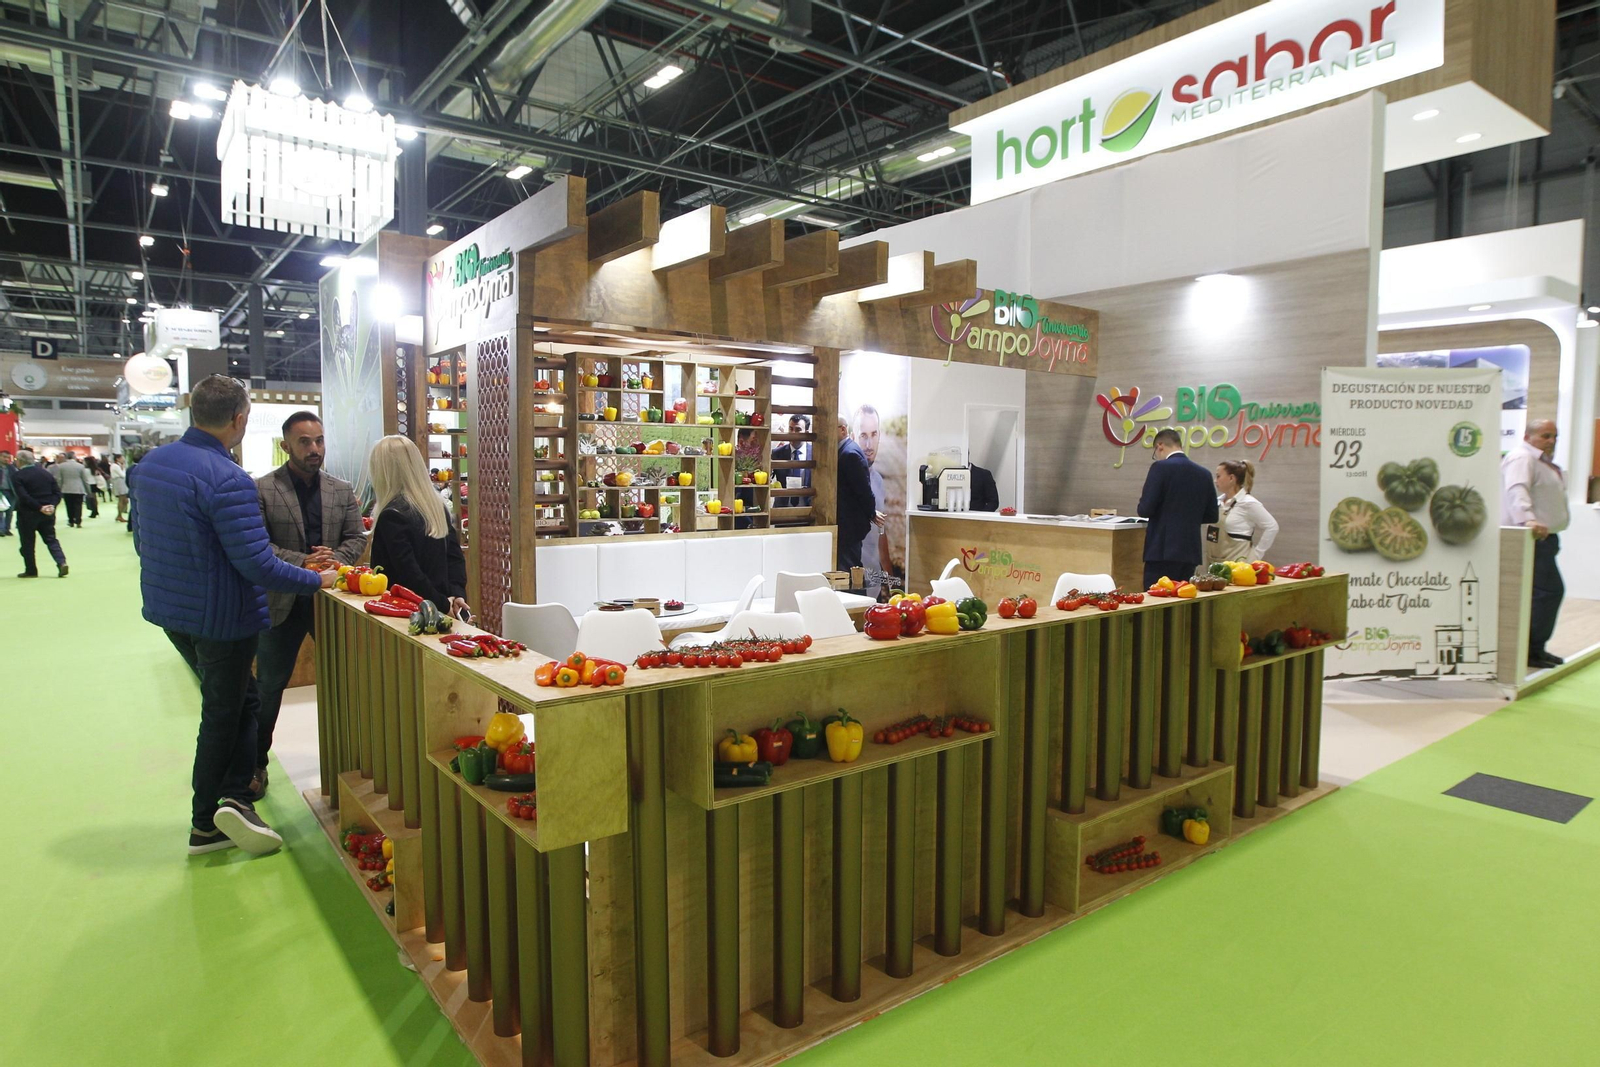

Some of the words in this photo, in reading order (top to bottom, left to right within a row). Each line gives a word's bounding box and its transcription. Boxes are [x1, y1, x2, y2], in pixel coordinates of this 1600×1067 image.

[1171, 1, 1396, 104] sabor
[1171, 41, 1396, 126] MEDITERRANEO
[36, 341, 53, 358] D
[1332, 382, 1416, 394] DEGUSTACIÓN
[1418, 384, 1433, 394] DE
[1436, 384, 1491, 394] NUESTRO
[1350, 400, 1413, 409] PRODUCTO
[1415, 400, 1473, 410] NOVEDAD
[1330, 426, 1366, 436] MIÉRCOLES
[1330, 440, 1362, 469] 23
[1348, 572, 1383, 587] mate
[1387, 571, 1452, 590] Chocolate
[1377, 594, 1393, 608] de
